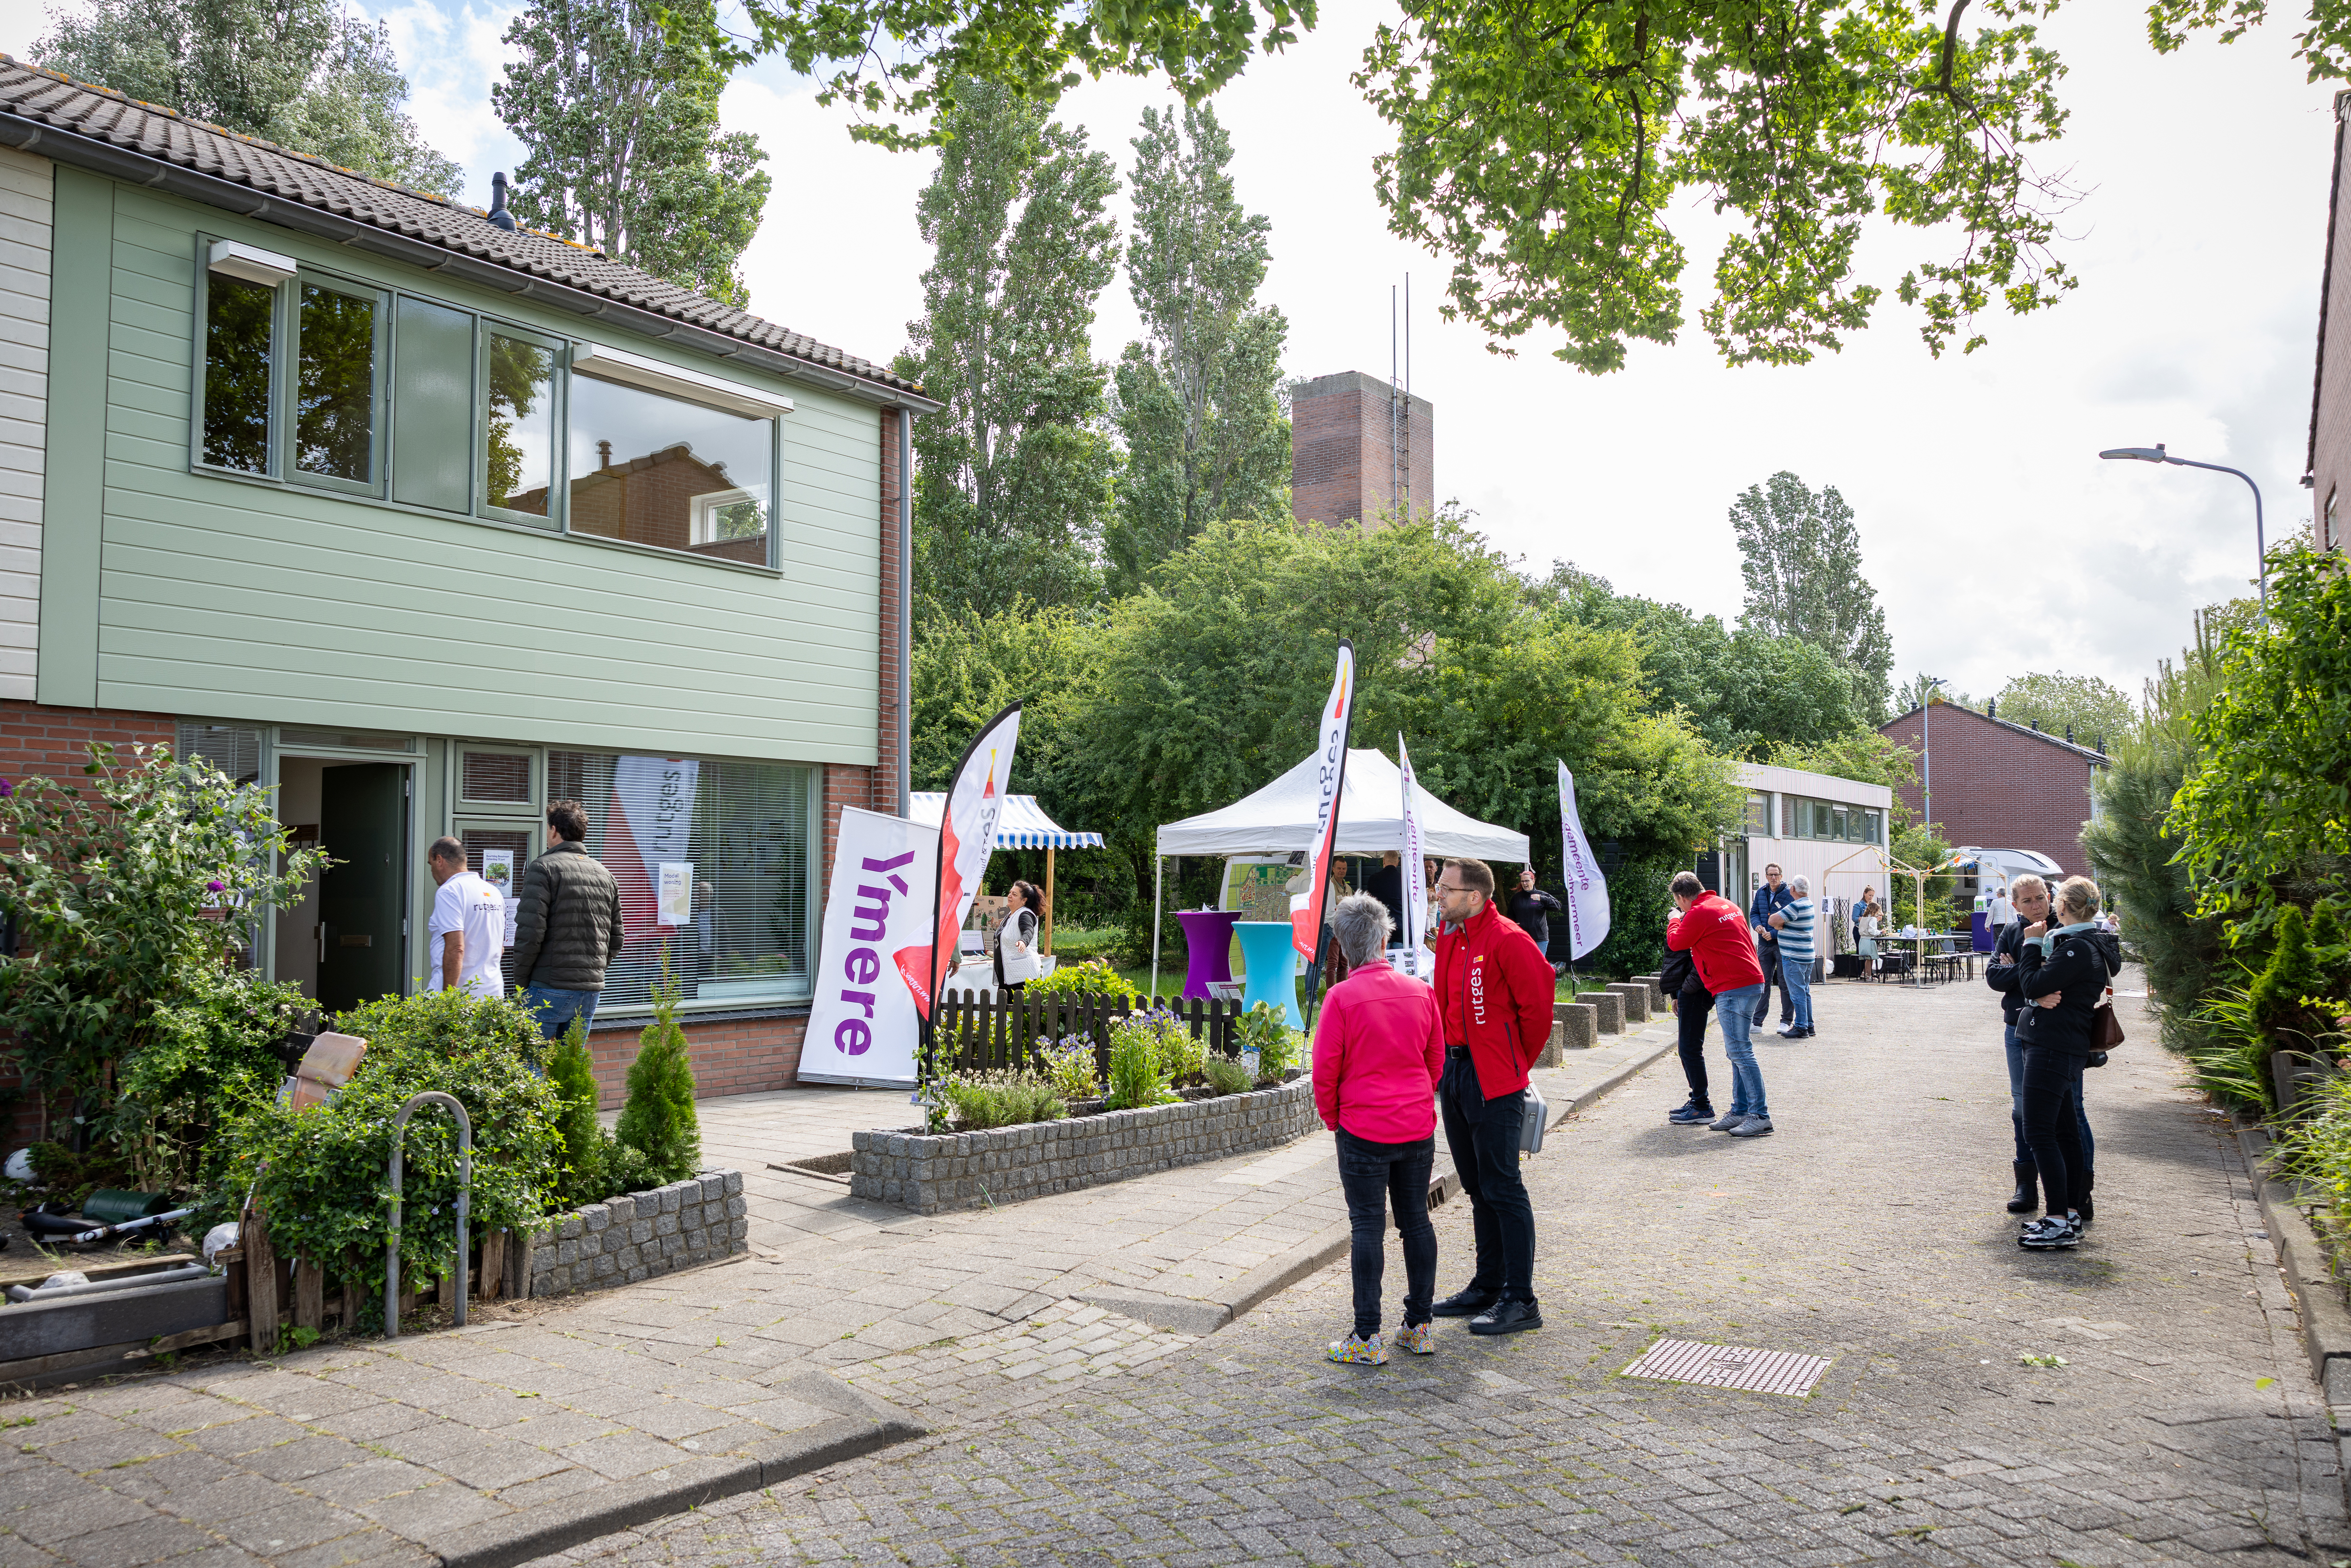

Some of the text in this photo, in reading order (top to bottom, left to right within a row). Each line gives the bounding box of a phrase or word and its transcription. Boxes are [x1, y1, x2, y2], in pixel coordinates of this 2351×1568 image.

[651, 770, 683, 852] rutges
[1718, 910, 1743, 923] rutges.nl
[834, 850, 915, 1055] Ymere
[1471, 968, 1486, 1025] rutges
